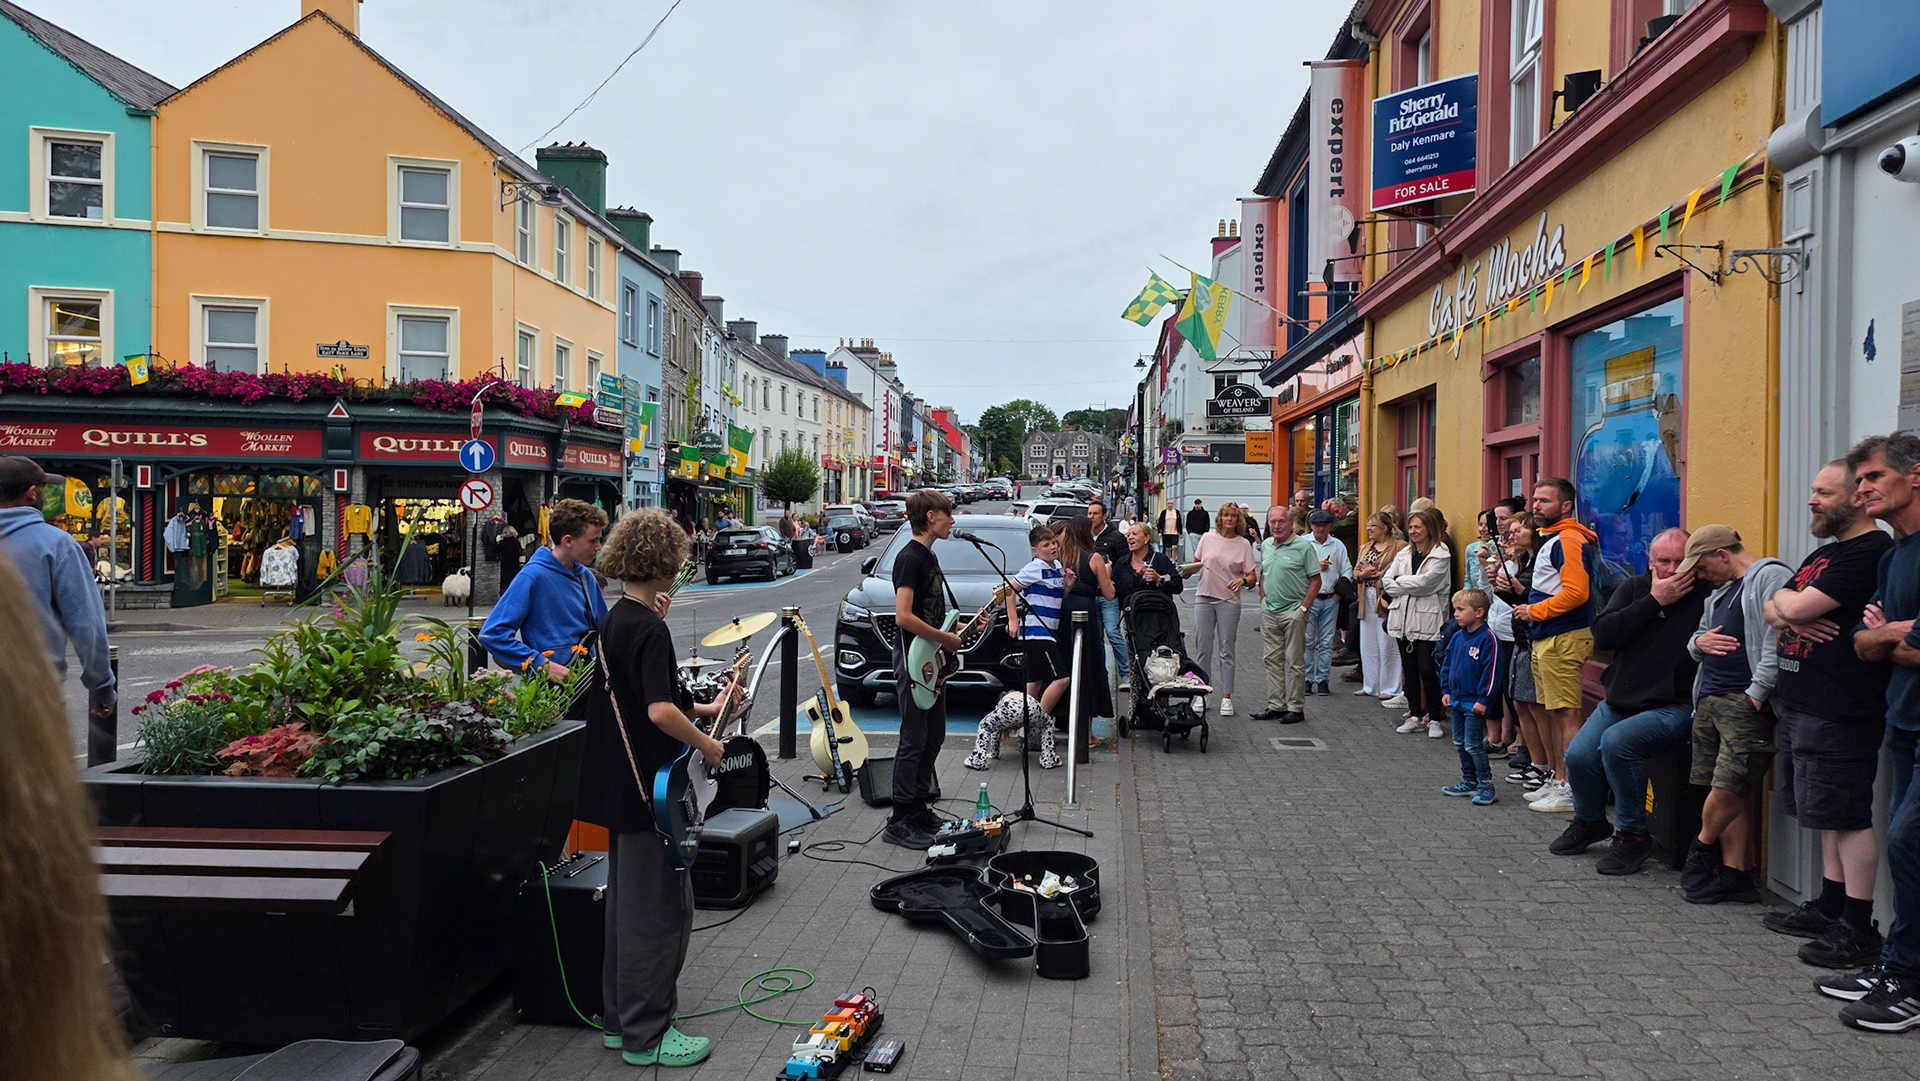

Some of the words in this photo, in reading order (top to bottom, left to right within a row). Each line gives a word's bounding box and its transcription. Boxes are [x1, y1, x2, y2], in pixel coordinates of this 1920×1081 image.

[1400, 92, 1446, 115] Sherry
[1389, 102, 1459, 133] FitzGerald
[1327, 98, 1345, 198] expert
[1390, 140, 1410, 152] Daly
[1412, 130, 1456, 147] Kenmare
[1404, 157, 1416, 166] 064
[1395, 185, 1417, 199] FOR
[1419, 178, 1449, 194] SALE
[1253, 223, 1265, 293] expert
[1428, 259, 1481, 360] Café
[1485, 211, 1566, 310] Mocha
[1217, 398, 1261, 408] WEAVERS
[0, 425, 58, 436] WOOLLEN
[82, 429, 208, 447] QUILL'S
[240, 431, 294, 442] WOOLLEN
[0, 435, 55, 446] MARKET
[241, 441, 292, 452] MARKET
[509, 441, 547, 458] QUILL'S
[579, 450, 607, 465] QUILL'S
[720, 753, 753, 773] SONOR
